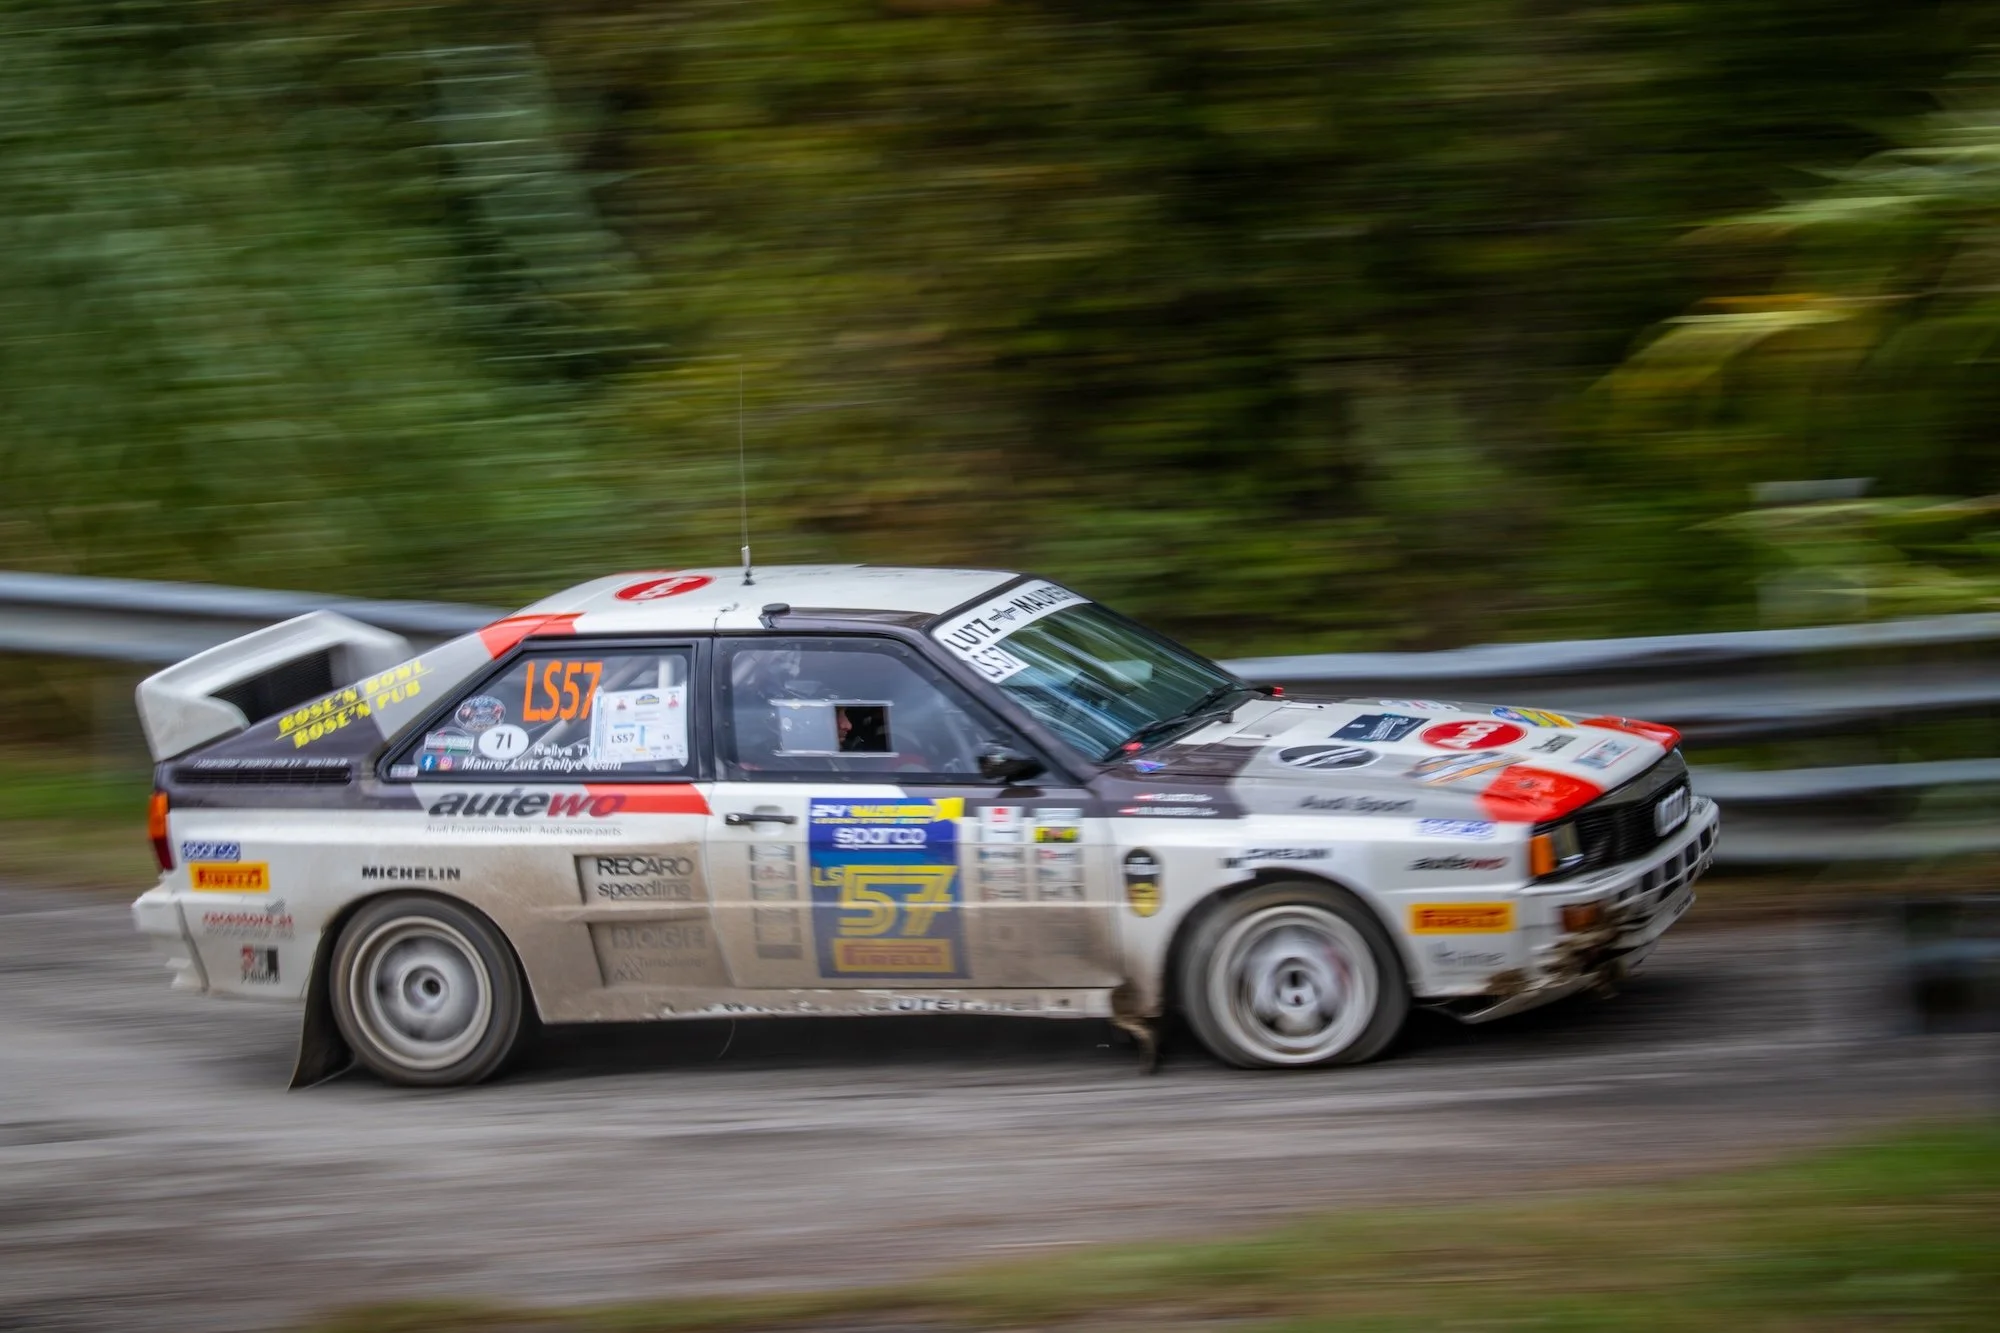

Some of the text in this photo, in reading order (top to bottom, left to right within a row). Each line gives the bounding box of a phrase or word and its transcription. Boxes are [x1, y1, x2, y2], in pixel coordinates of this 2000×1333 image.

[944, 617, 1002, 652] LUTZ
[972, 646, 1020, 678] LS57
[365, 659, 423, 695] BOWL
[376, 679, 421, 711] PUB
[523, 660, 603, 722] LS57
[611, 733, 634, 744] LS57
[462, 757, 621, 773] Maurer Lutz Rallye eam
[834, 827, 928, 845] sparco
[362, 866, 460, 880] MICHELIN
[599, 857, 694, 876] RECARO
[598, 878, 693, 899] speedline
[838, 865, 958, 936] 57
[844, 945, 942, 965] PIRELLI
